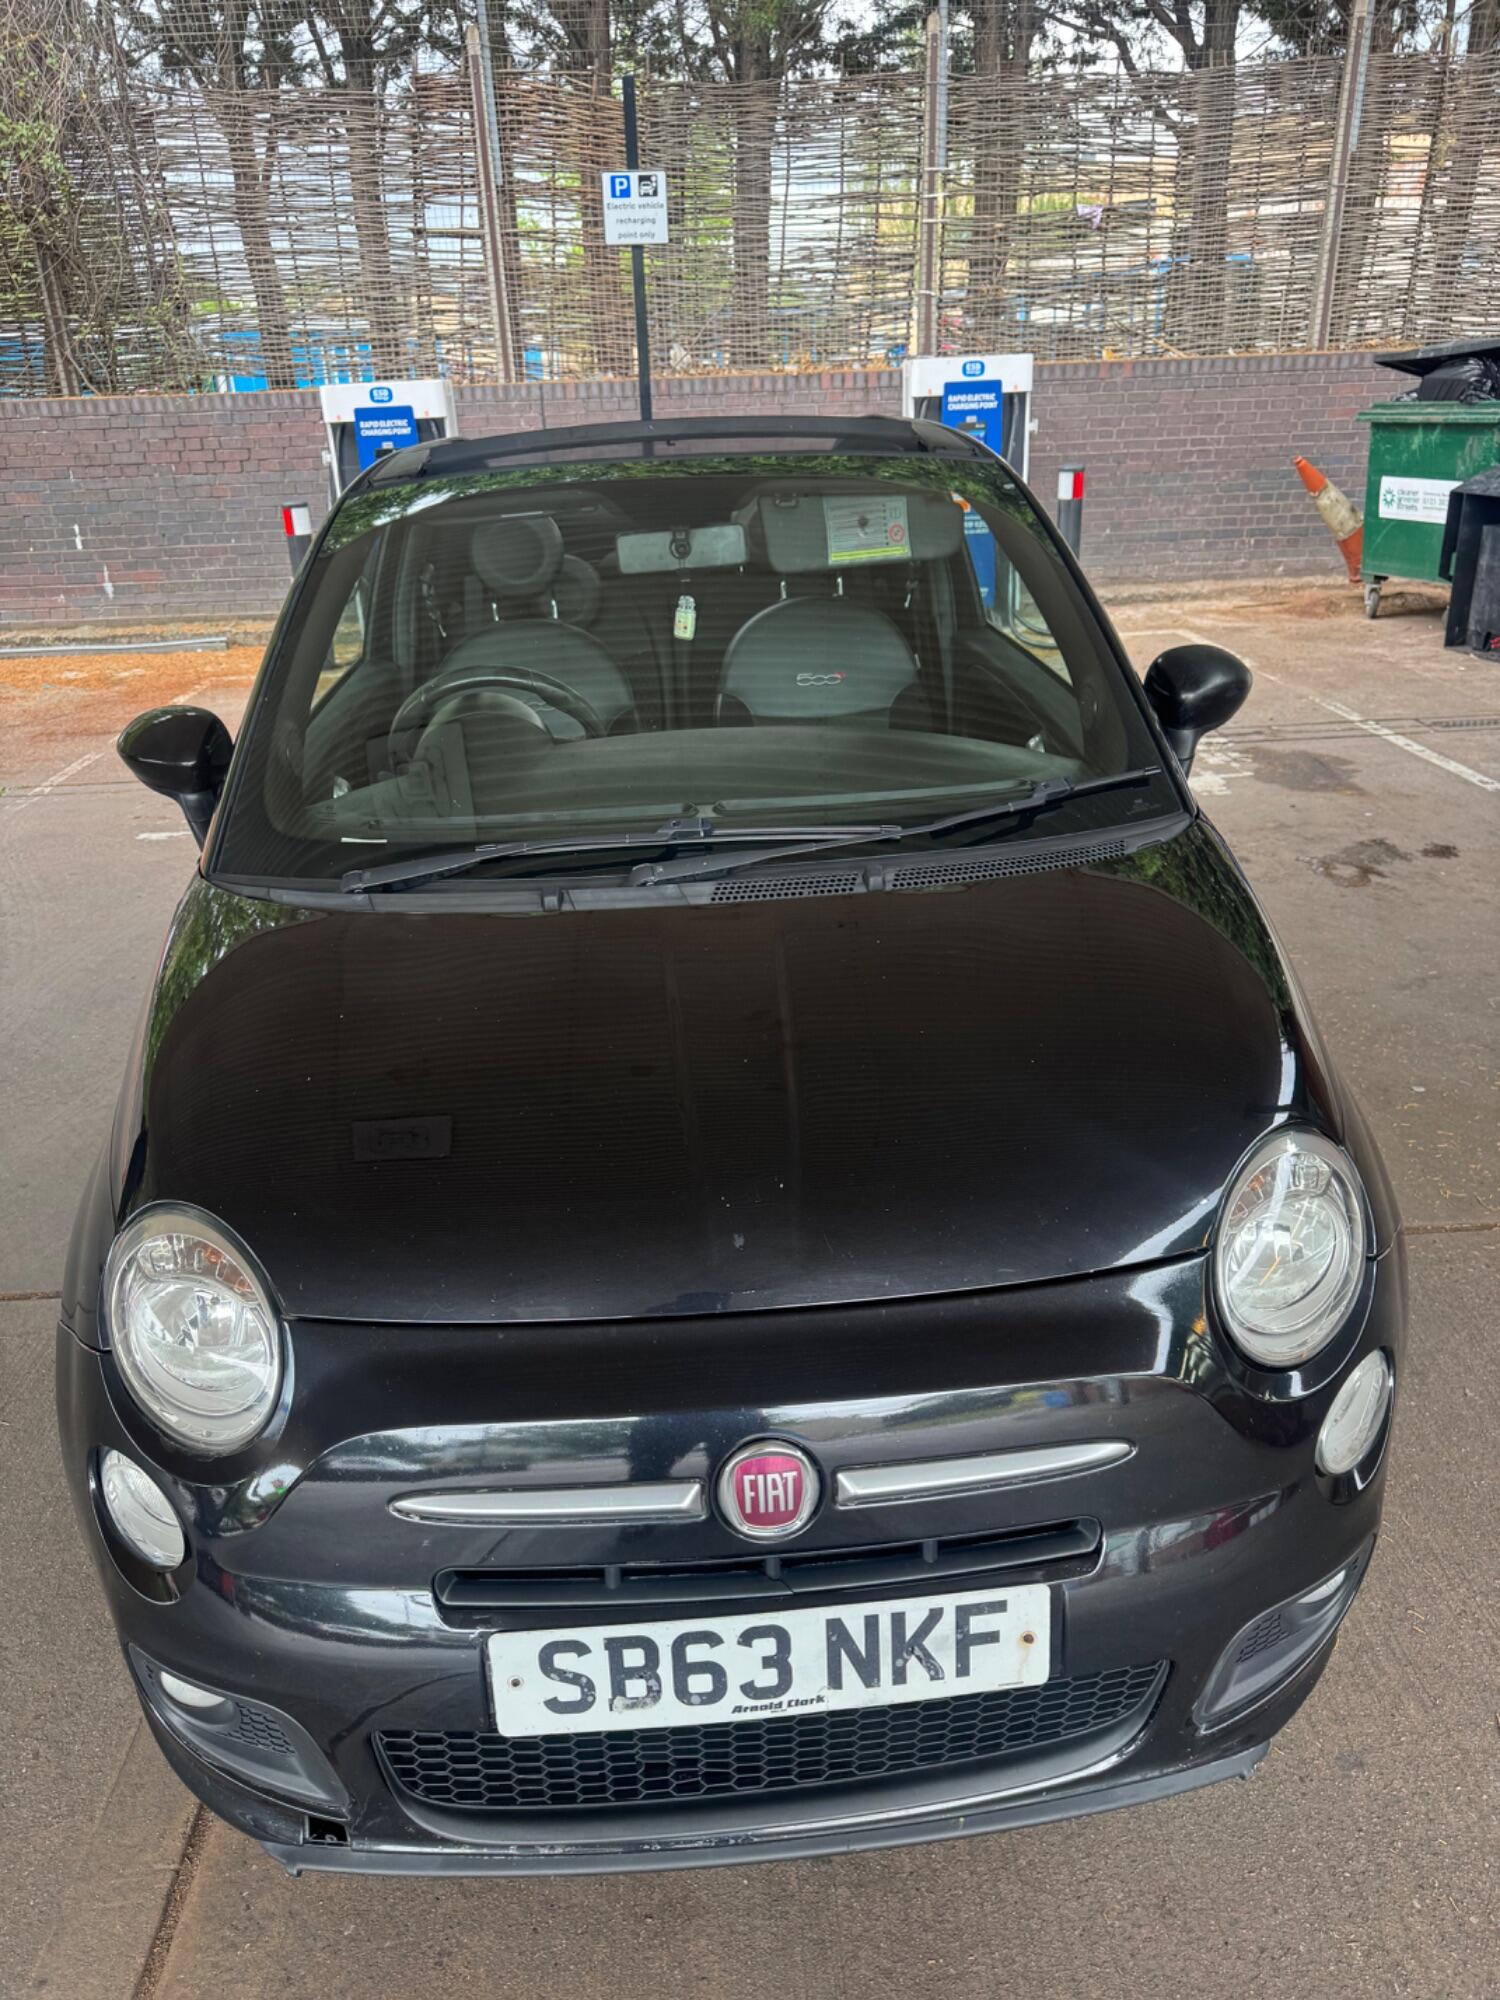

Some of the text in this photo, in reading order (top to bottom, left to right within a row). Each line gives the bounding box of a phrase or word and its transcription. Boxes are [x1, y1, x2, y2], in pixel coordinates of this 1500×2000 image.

[615, 178, 628, 196] P
[607, 201, 664, 210] Electric vehicle
[616, 217, 656, 225] recharging
[640, 231, 656, 239] only
[968, 393, 996, 401] ELECTRIC
[948, 401, 998, 410] CHARGING POINT
[379, 419, 408, 427] ELECTRIC
[392, 427, 411, 435] POINT
[743, 1471, 797, 1514] FIAT
[538, 1600, 1007, 1714] SB63 NKF
[731, 1695, 825, 1714] Arnold Clark
